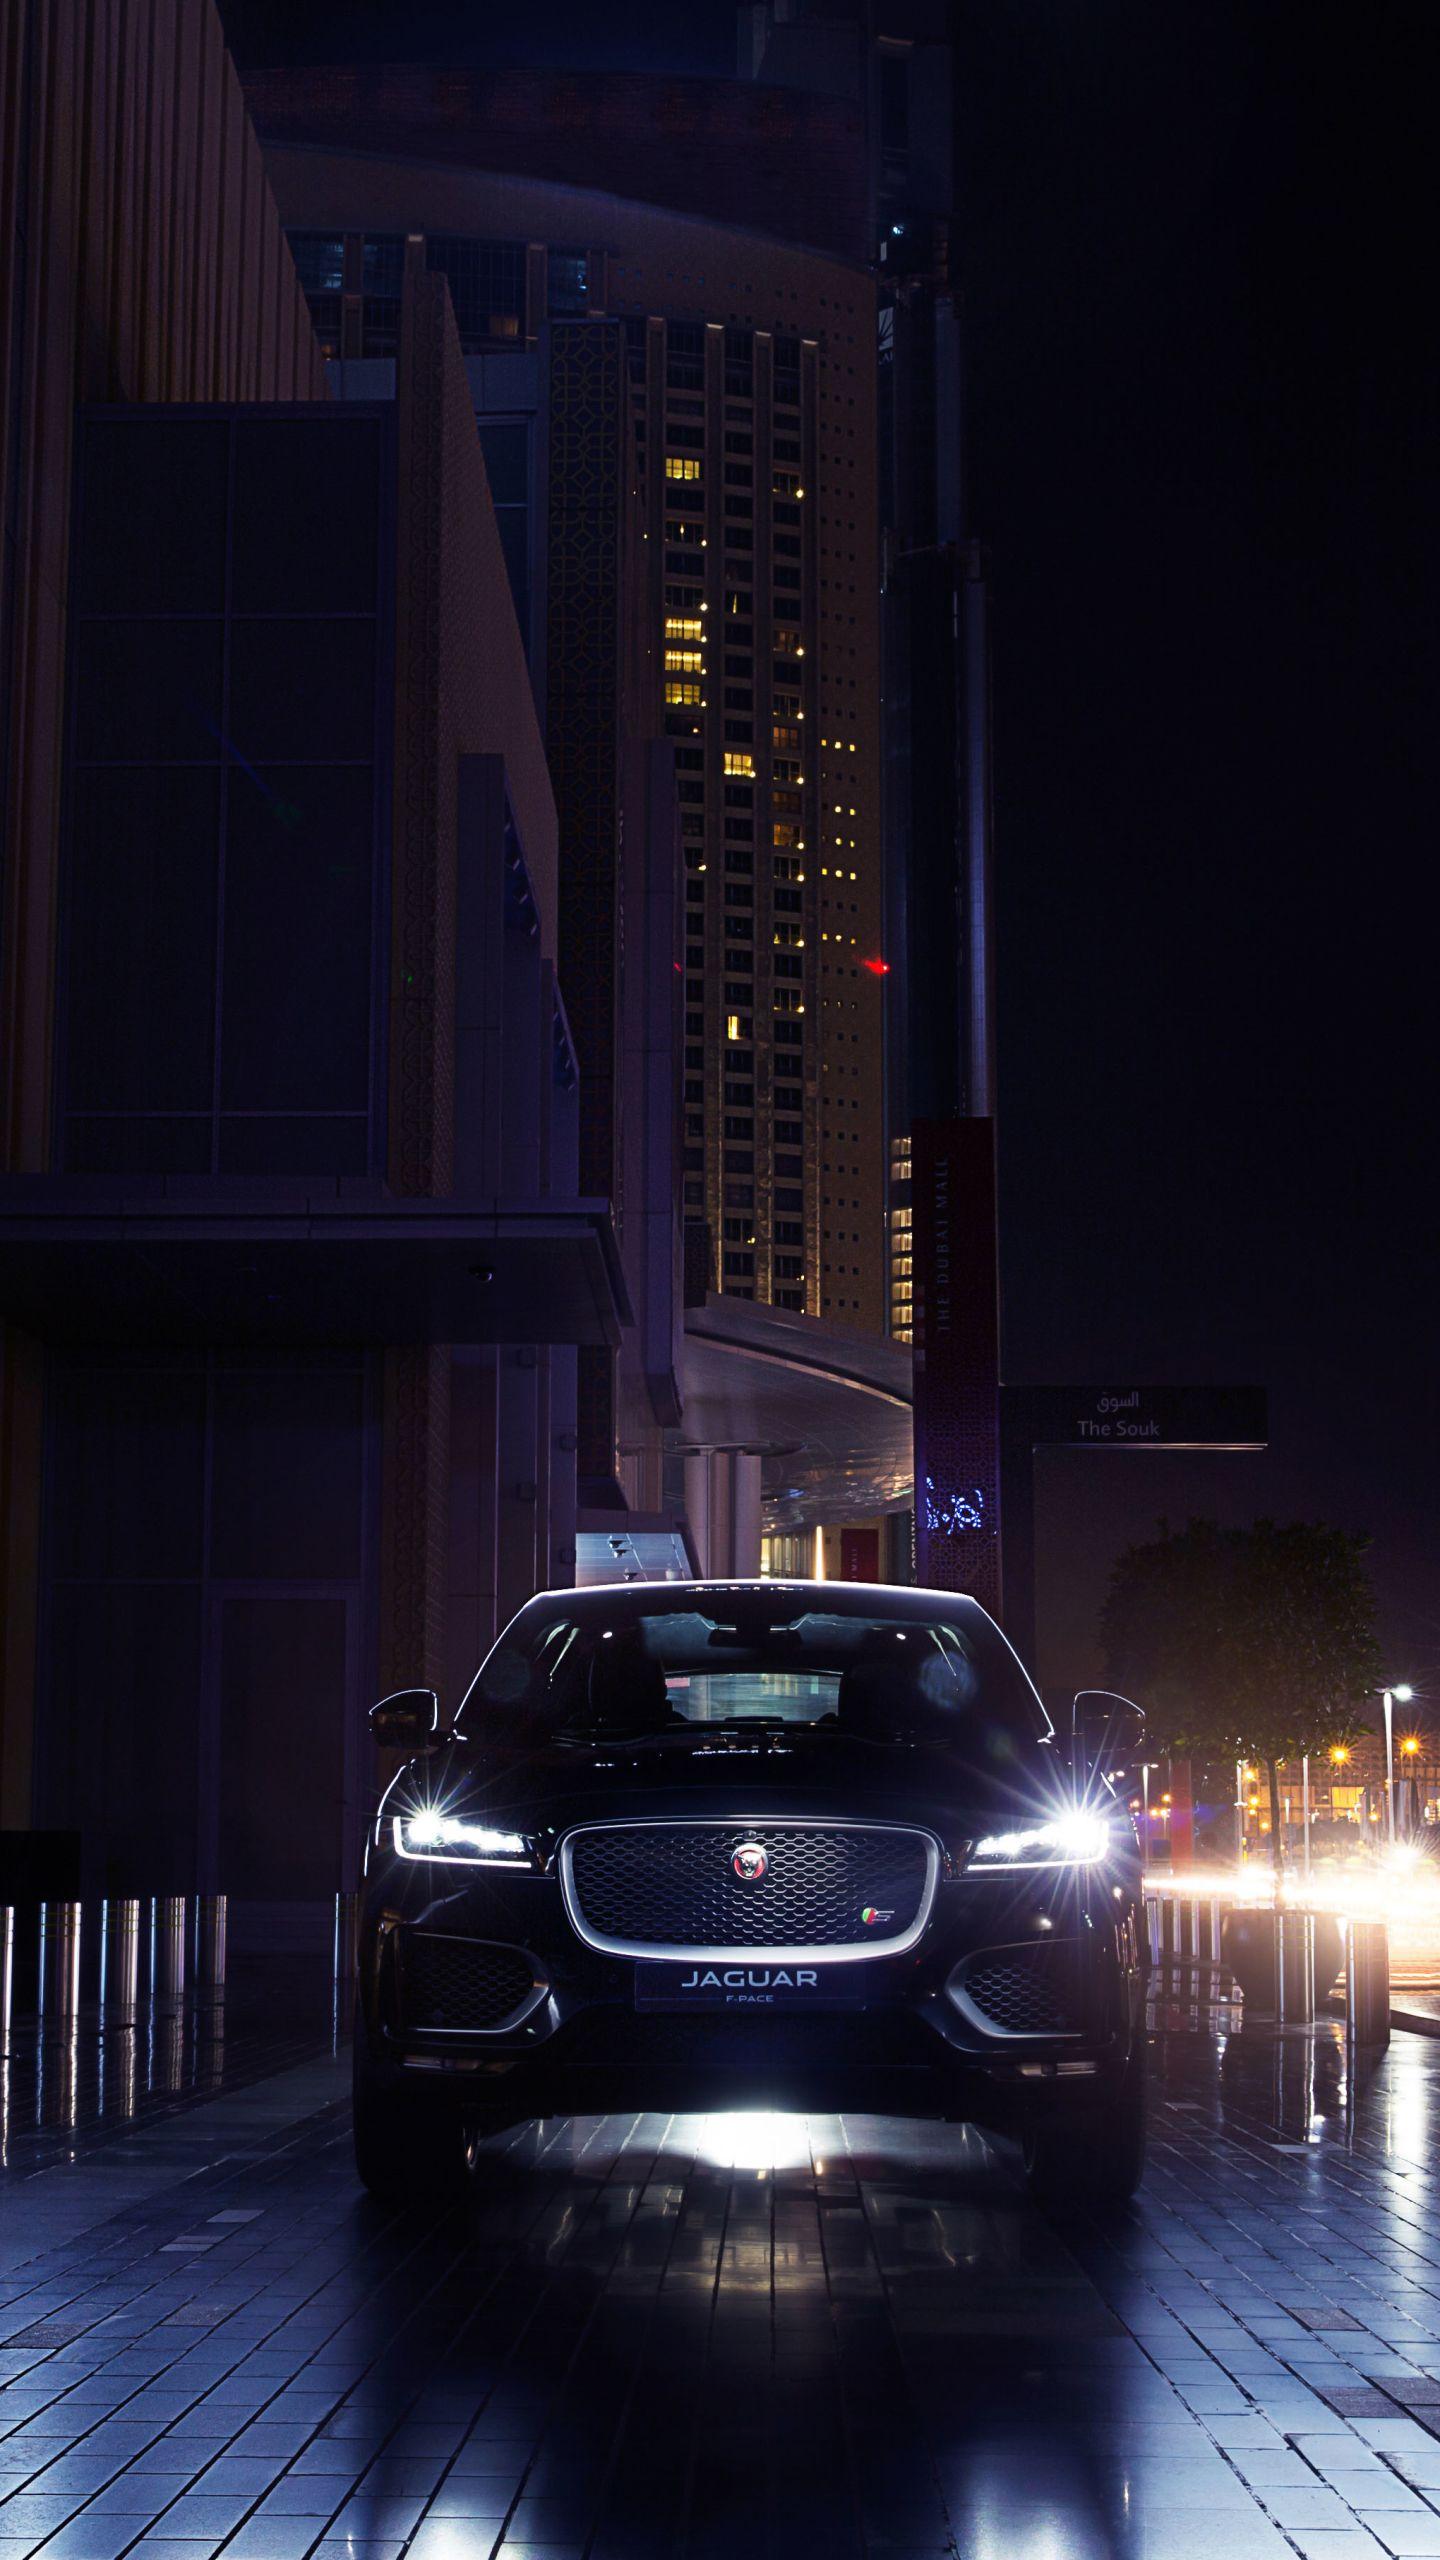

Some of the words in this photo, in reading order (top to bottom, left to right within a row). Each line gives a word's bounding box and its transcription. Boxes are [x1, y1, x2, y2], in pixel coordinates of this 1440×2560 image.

[935, 1153, 950, 1209] MALL
[935, 1217, 950, 1286] DUBAI
[1097, 1391, 1139, 1413] السوق
[1077, 1420, 1111, 1436] The
[1116, 1420, 1160, 1436] Souk
[681, 1970, 818, 1987] JAGUAR
